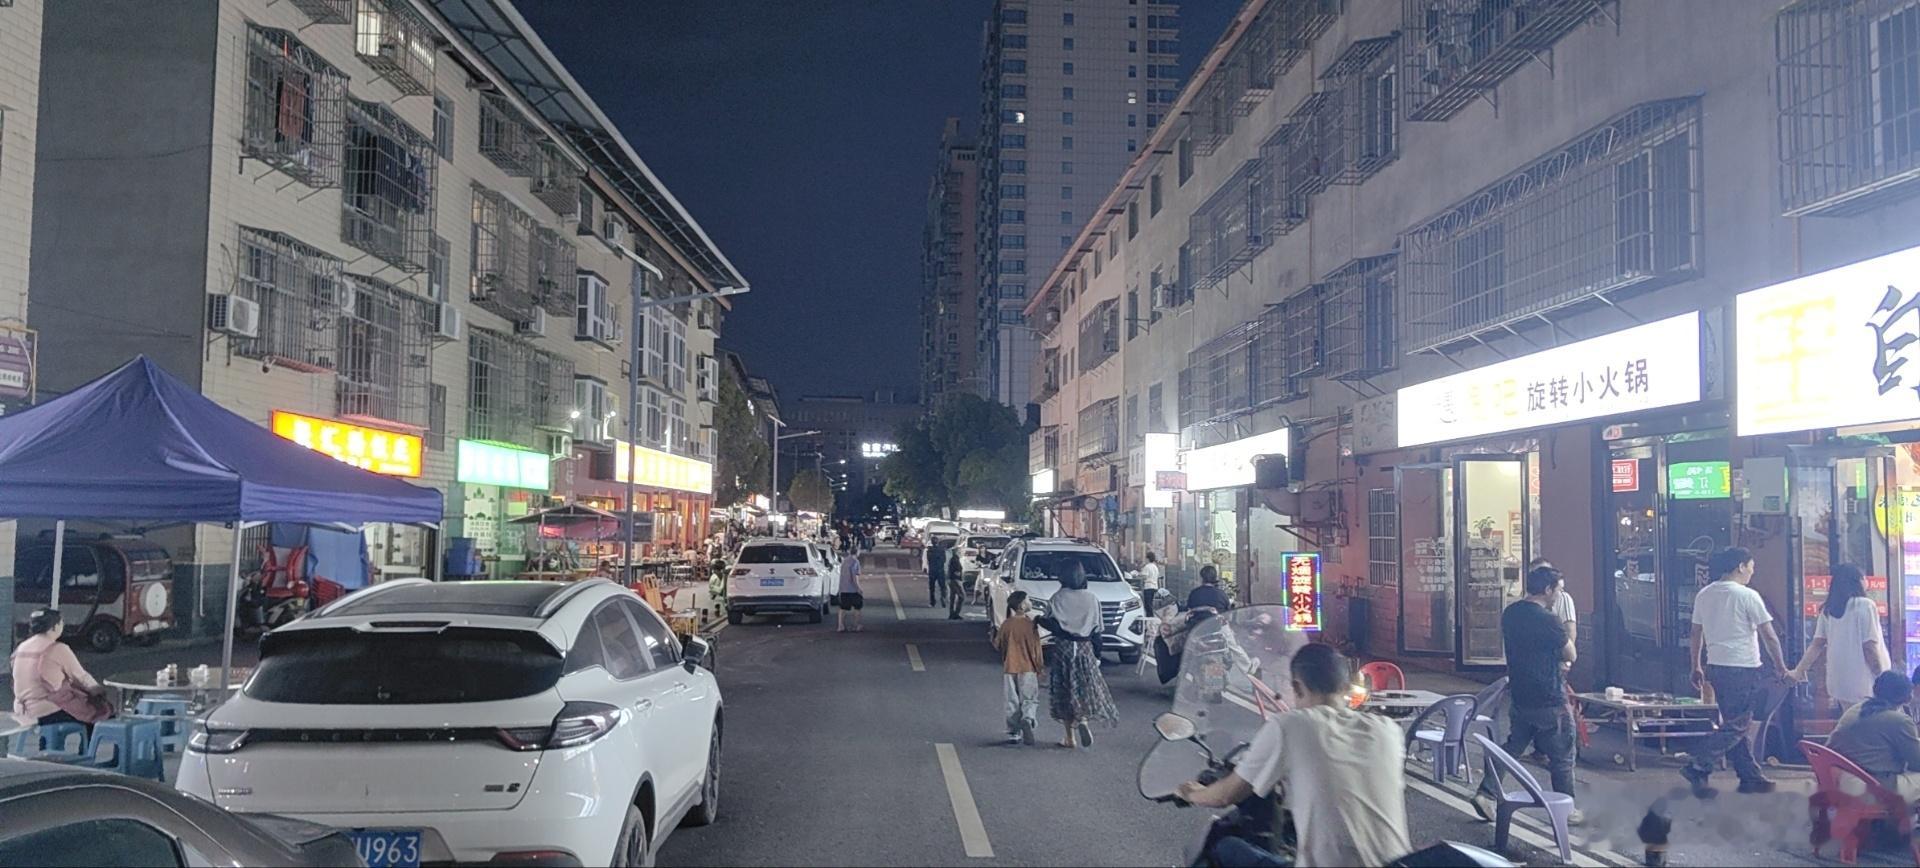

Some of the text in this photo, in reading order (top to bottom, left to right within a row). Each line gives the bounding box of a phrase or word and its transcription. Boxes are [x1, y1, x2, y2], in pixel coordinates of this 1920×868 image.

[1527, 358, 1649, 412] 旋转小火锅
